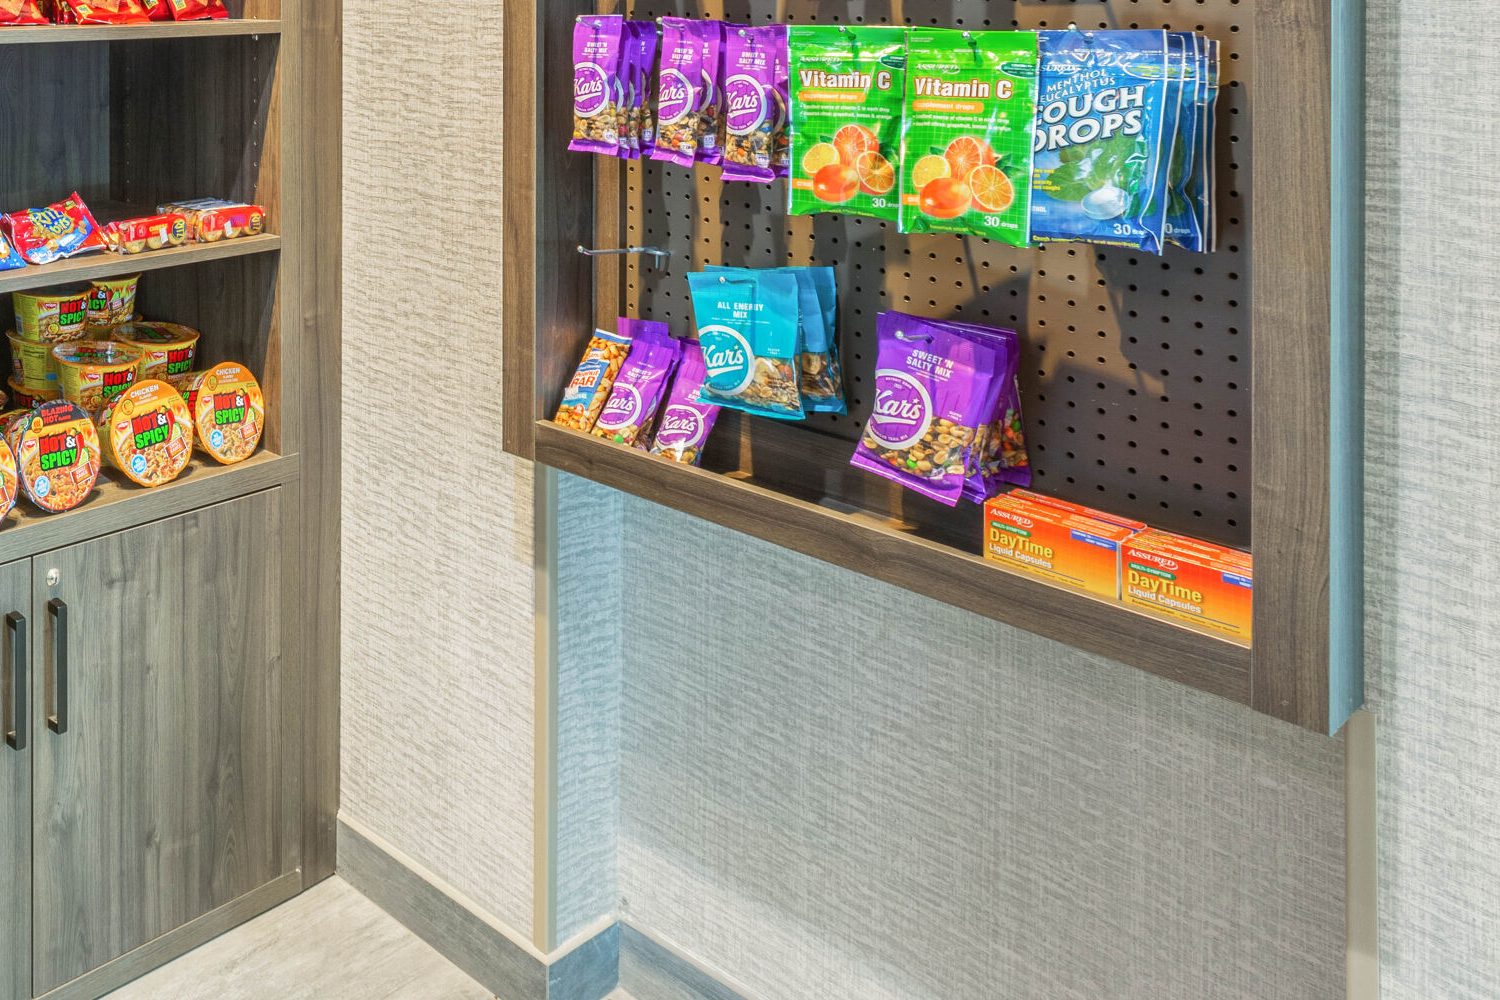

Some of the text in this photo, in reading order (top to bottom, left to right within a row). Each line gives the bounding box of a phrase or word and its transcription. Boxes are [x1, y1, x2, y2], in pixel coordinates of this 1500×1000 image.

[915, 64, 959, 72] ASSURED
[800, 70, 892, 90] Vitamin C
[1046, 69, 1107, 93] MENTHOL
[914, 77, 1013, 99] Vitamin C
[840, 93, 858, 101] drops
[955, 103, 975, 111] drops
[984, 215, 1018, 230] 30 drops
[1113, 224, 1131, 235] 30
[717, 301, 764, 312] ALL ENERGY
[733, 310, 748, 319] MIX
[911, 349, 943, 365] SWEET
[216, 367, 241, 377] CHICKEN
[575, 368, 600, 378] Peanut
[906, 356, 951, 379] SALTY MIX
[570, 375, 596, 388] BAR
[130, 384, 159, 399] CHICKEN
[214, 392, 244, 410] HOT &
[41, 405, 73, 417] BLAZING
[43, 414, 58, 424] HOT
[132, 411, 167, 435] HOT &
[990, 508, 1031, 527] ASSURED
[990, 528, 1053, 559] DayTime
[989, 543, 1052, 569] Liquid Capsules
[1128, 571, 1203, 604] DayTime
[1128, 585, 1202, 614] Liquid Capsules
